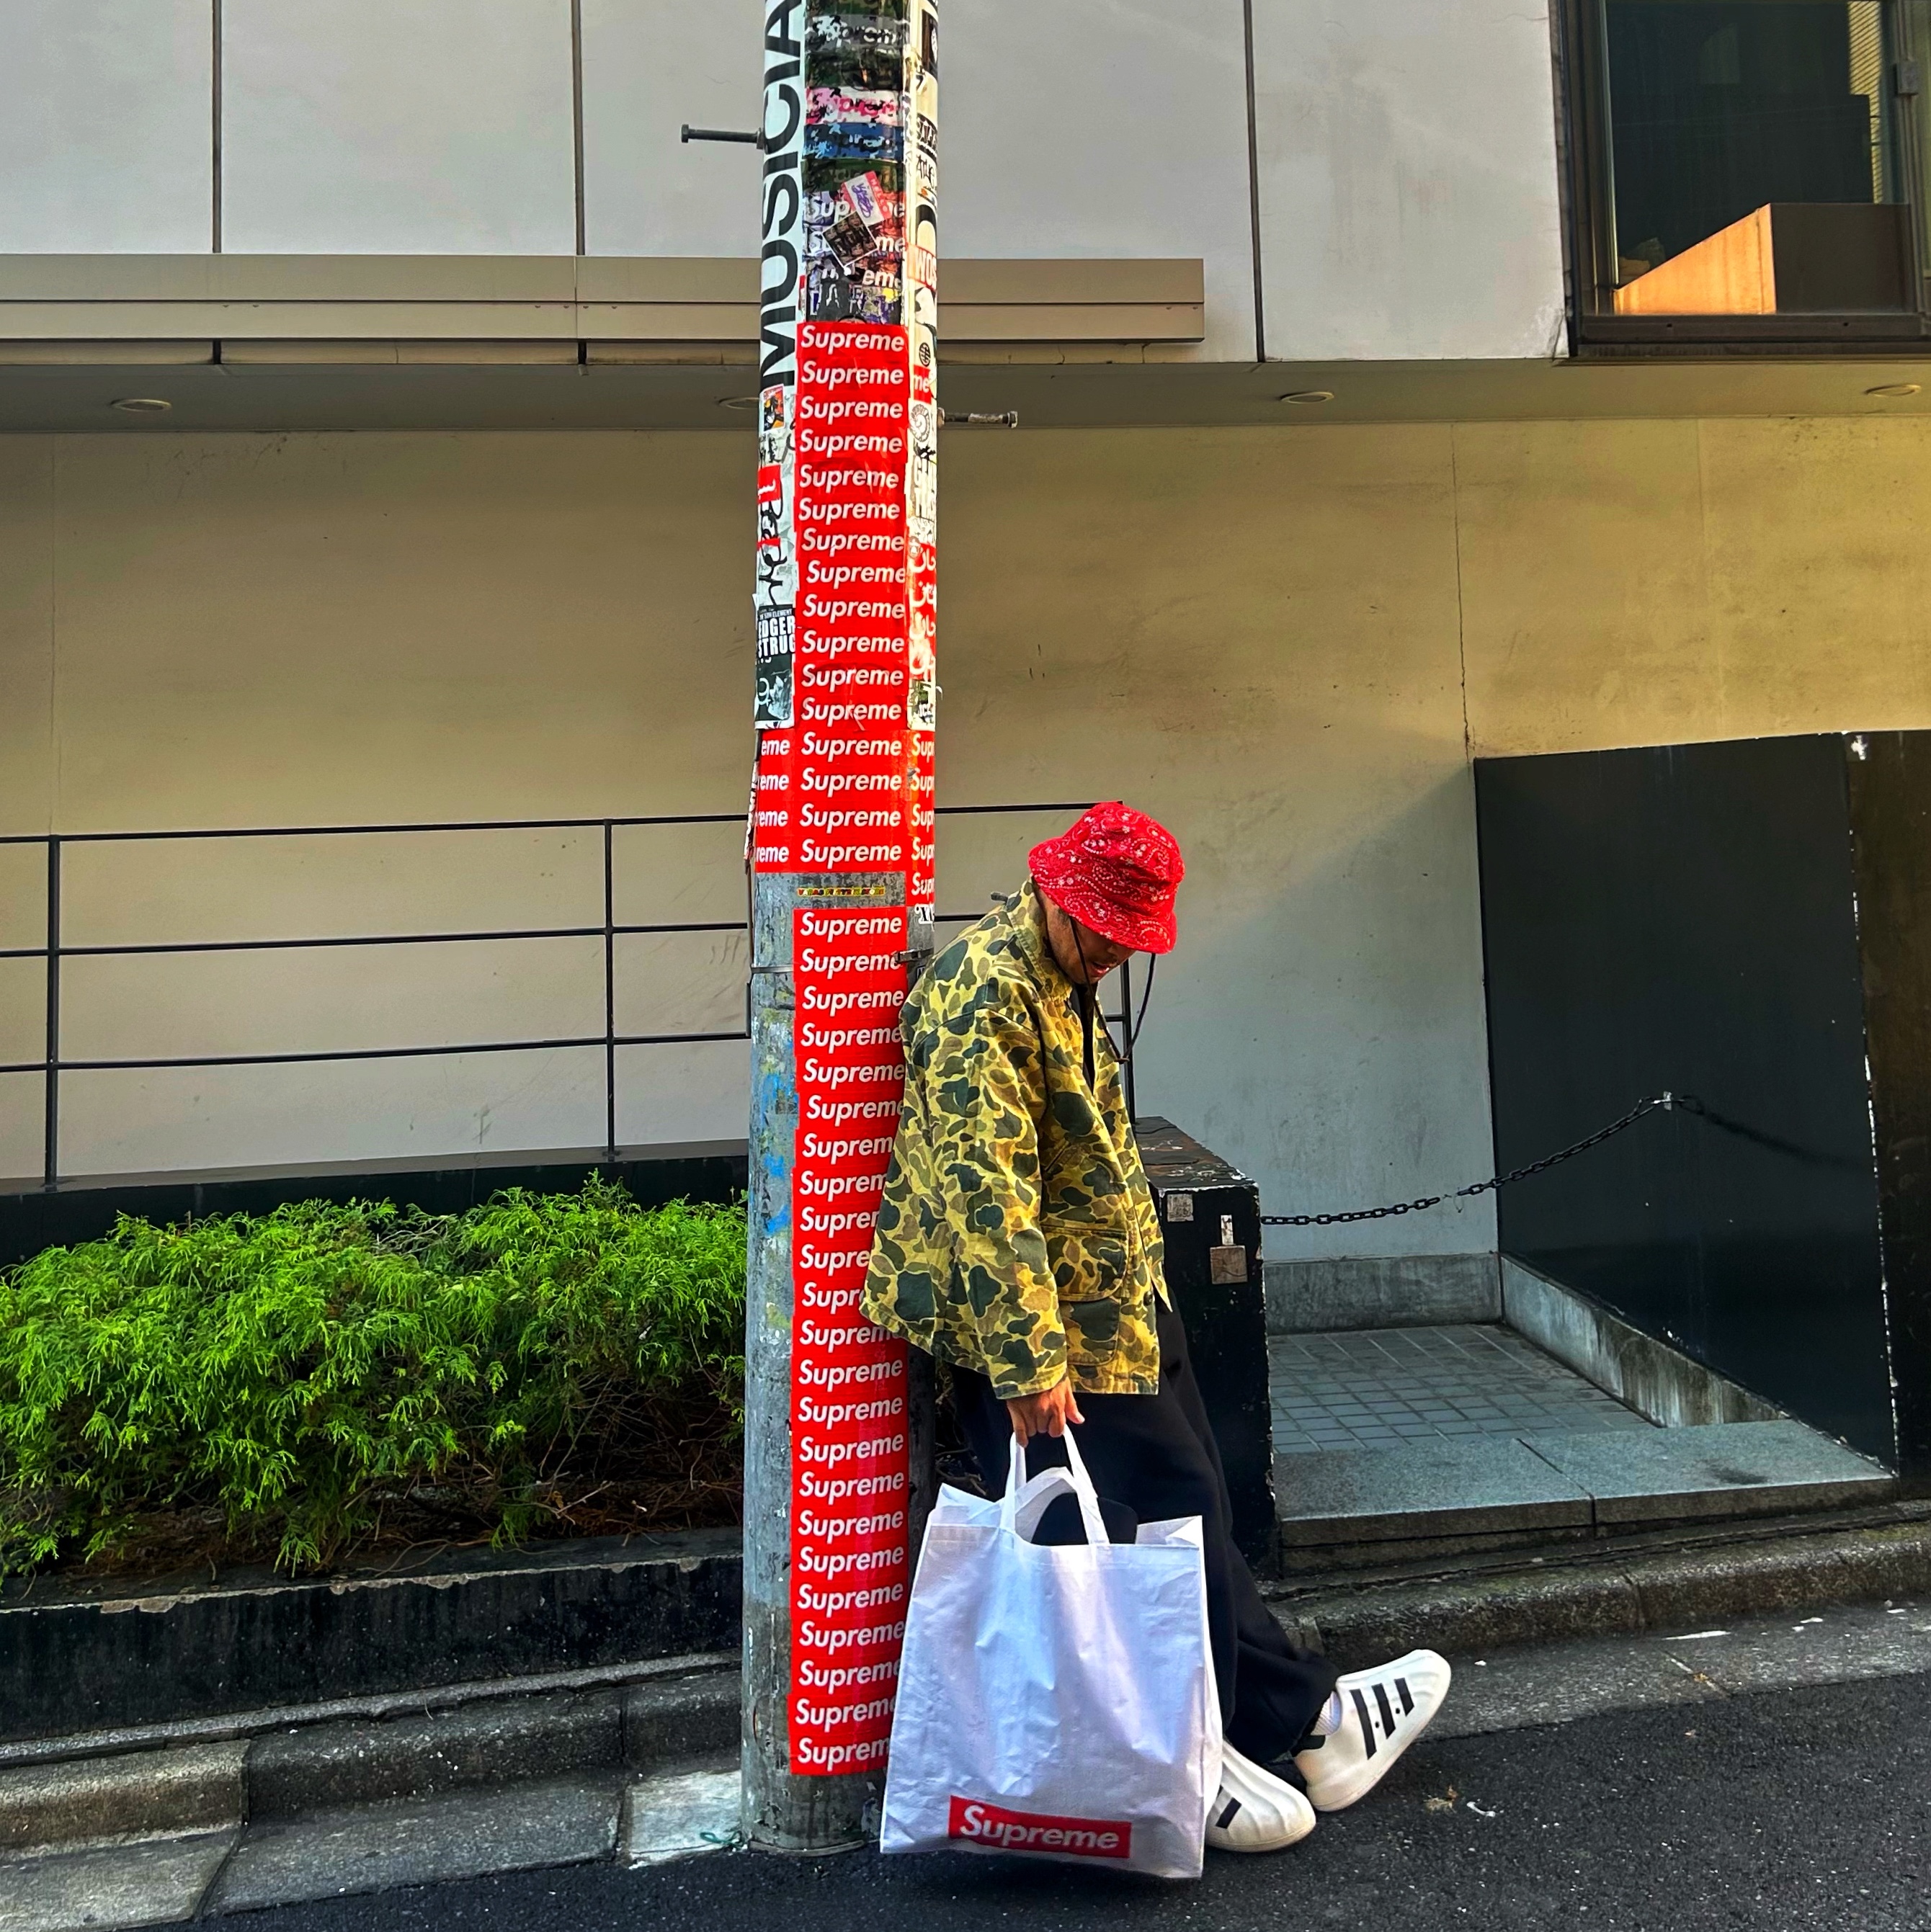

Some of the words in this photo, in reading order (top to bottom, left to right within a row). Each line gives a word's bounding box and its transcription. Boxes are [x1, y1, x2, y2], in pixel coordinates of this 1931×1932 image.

[801, 325, 905, 354] Supreme
[801, 360, 904, 390] Supreme
[800, 396, 903, 424] Supreme
[800, 429, 902, 457] Supreme
[800, 465, 898, 493] Supreme
[798, 498, 899, 524] Supreme
[802, 528, 904, 556] Supreme
[806, 560, 905, 589] Supreme
[803, 594, 905, 623] Supreme
[802, 630, 904, 659] Supreme
[802, 664, 903, 692] Supreme
[801, 697, 901, 727] Supreme
[801, 732, 901, 761] Supreme
[801, 767, 901, 797] Supreme
[800, 803, 901, 833] Supreme
[801, 838, 901, 869] Supreme
[801, 912, 901, 942] Supreme
[802, 985, 904, 1016] Supreme
[801, 1023, 901, 1054] Supreme
[803, 1058, 904, 1090] Supreme
[802, 1133, 893, 1165] Suprem
[799, 1171, 887, 1202] Suprem
[799, 1207, 880, 1238] Supre
[799, 1244, 870, 1276] Supre
[801, 1282, 865, 1314] Supr
[799, 1320, 901, 1353] Suprem
[799, 1359, 902, 1392] Supreme
[798, 1397, 902, 1429] Supreme
[800, 1434, 904, 1469] Supreme
[799, 1472, 904, 1505] Supreme
[798, 1510, 903, 1544] Supreme
[798, 1547, 904, 1580] Supreme
[798, 1583, 903, 1617] Supreme
[798, 1621, 904, 1655] Supreme
[798, 1738, 890, 1771] Suprem
[960, 1804, 1120, 1848] Supreme
